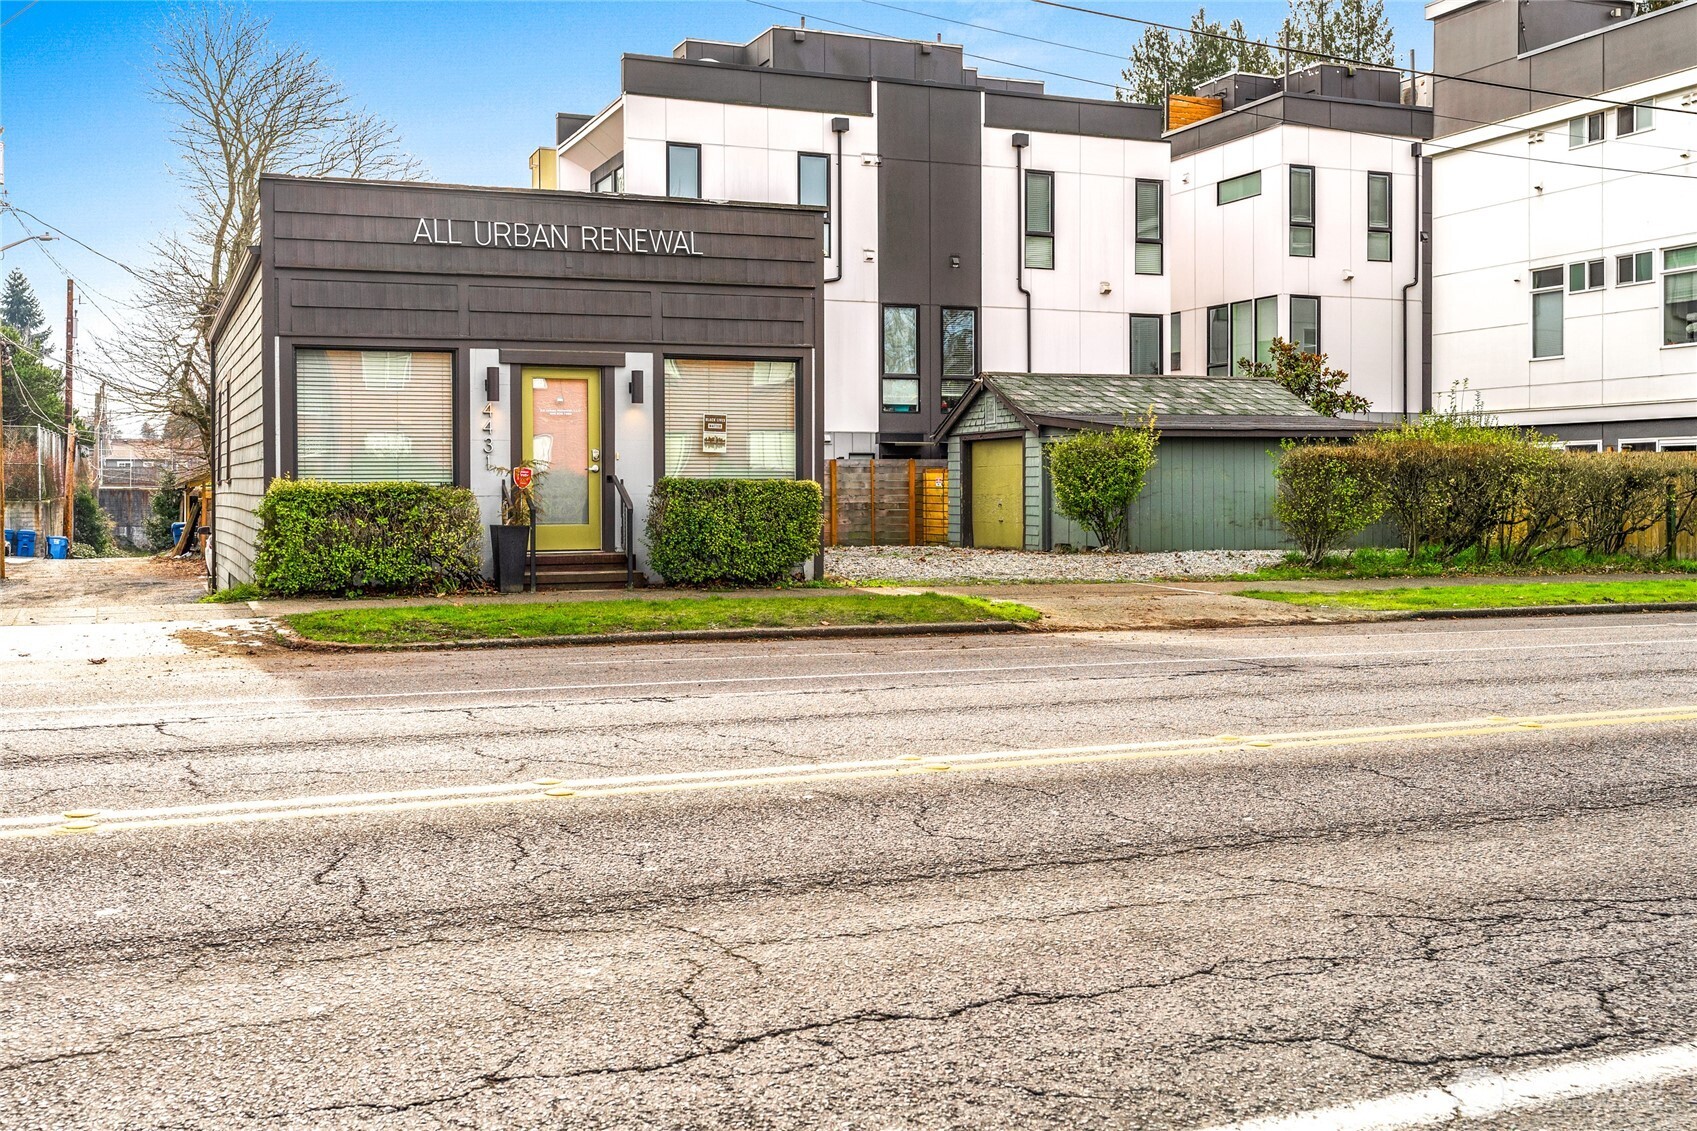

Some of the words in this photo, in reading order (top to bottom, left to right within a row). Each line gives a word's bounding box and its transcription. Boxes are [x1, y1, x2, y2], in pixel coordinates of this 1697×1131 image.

[413, 218, 462, 244] ALL
[475, 221, 568, 249] URBAN
[582, 226, 704, 255] RENEWAL
[482, 402, 494, 471] 4431
